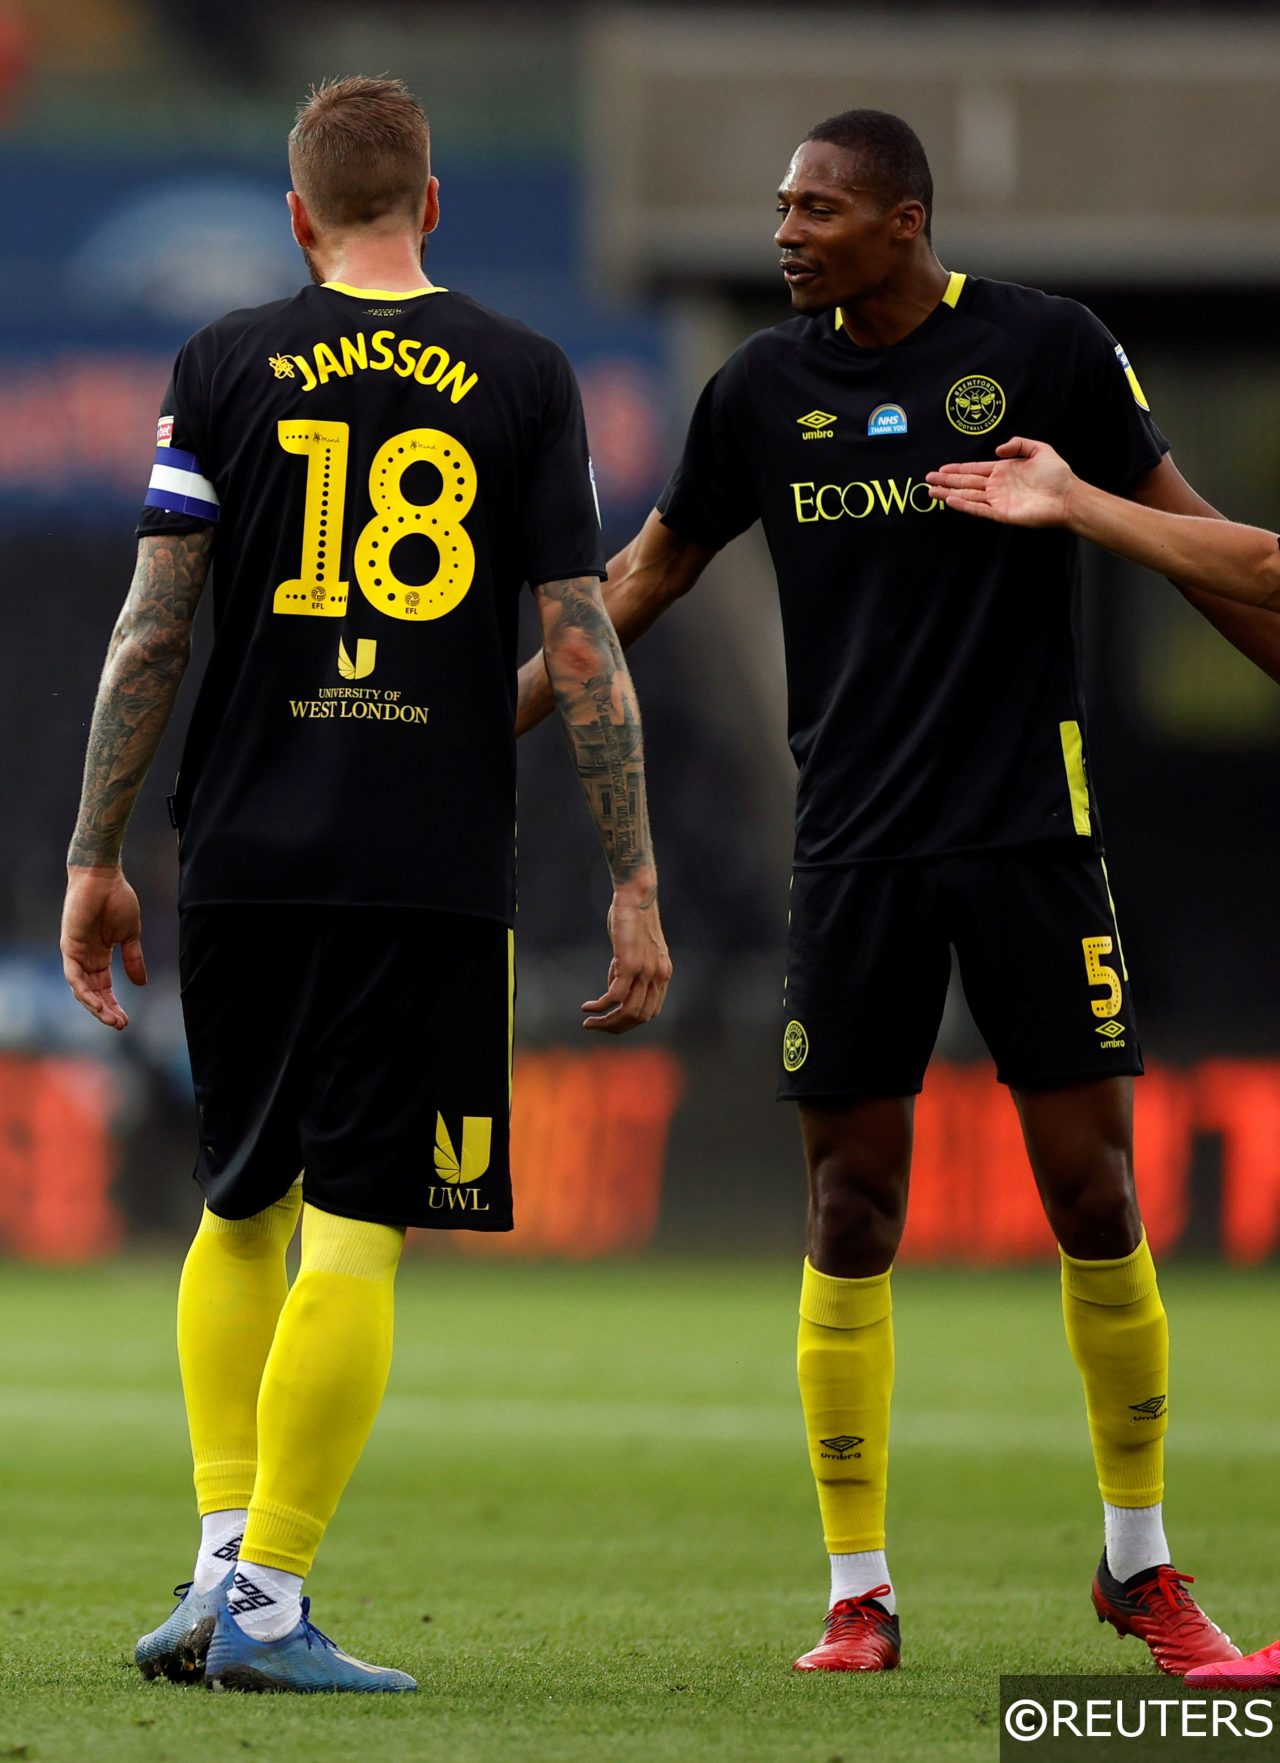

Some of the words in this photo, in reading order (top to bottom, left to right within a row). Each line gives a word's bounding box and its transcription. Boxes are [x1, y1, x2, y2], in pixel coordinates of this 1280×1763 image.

[293, 330, 479, 404] JANSSON
[954, 379, 996, 396] BRENTFORD
[878, 415, 899, 426] NHS
[802, 429, 834, 440] umbro
[871, 426, 892, 434] THANK
[789, 477, 945, 523] ECOWO
[273, 419, 478, 621] 18
[312, 602, 324, 610] EFL
[405, 607, 418, 615] EFL
[318, 688, 381, 700] UNIVERSITY
[384, 690, 402, 701] OF
[289, 700, 338, 718] WEST
[339, 701, 430, 724] LONDON
[1082, 936, 1122, 1018] 5
[1100, 1039, 1125, 1049] umbro
[427, 1186, 490, 1210] UWL
